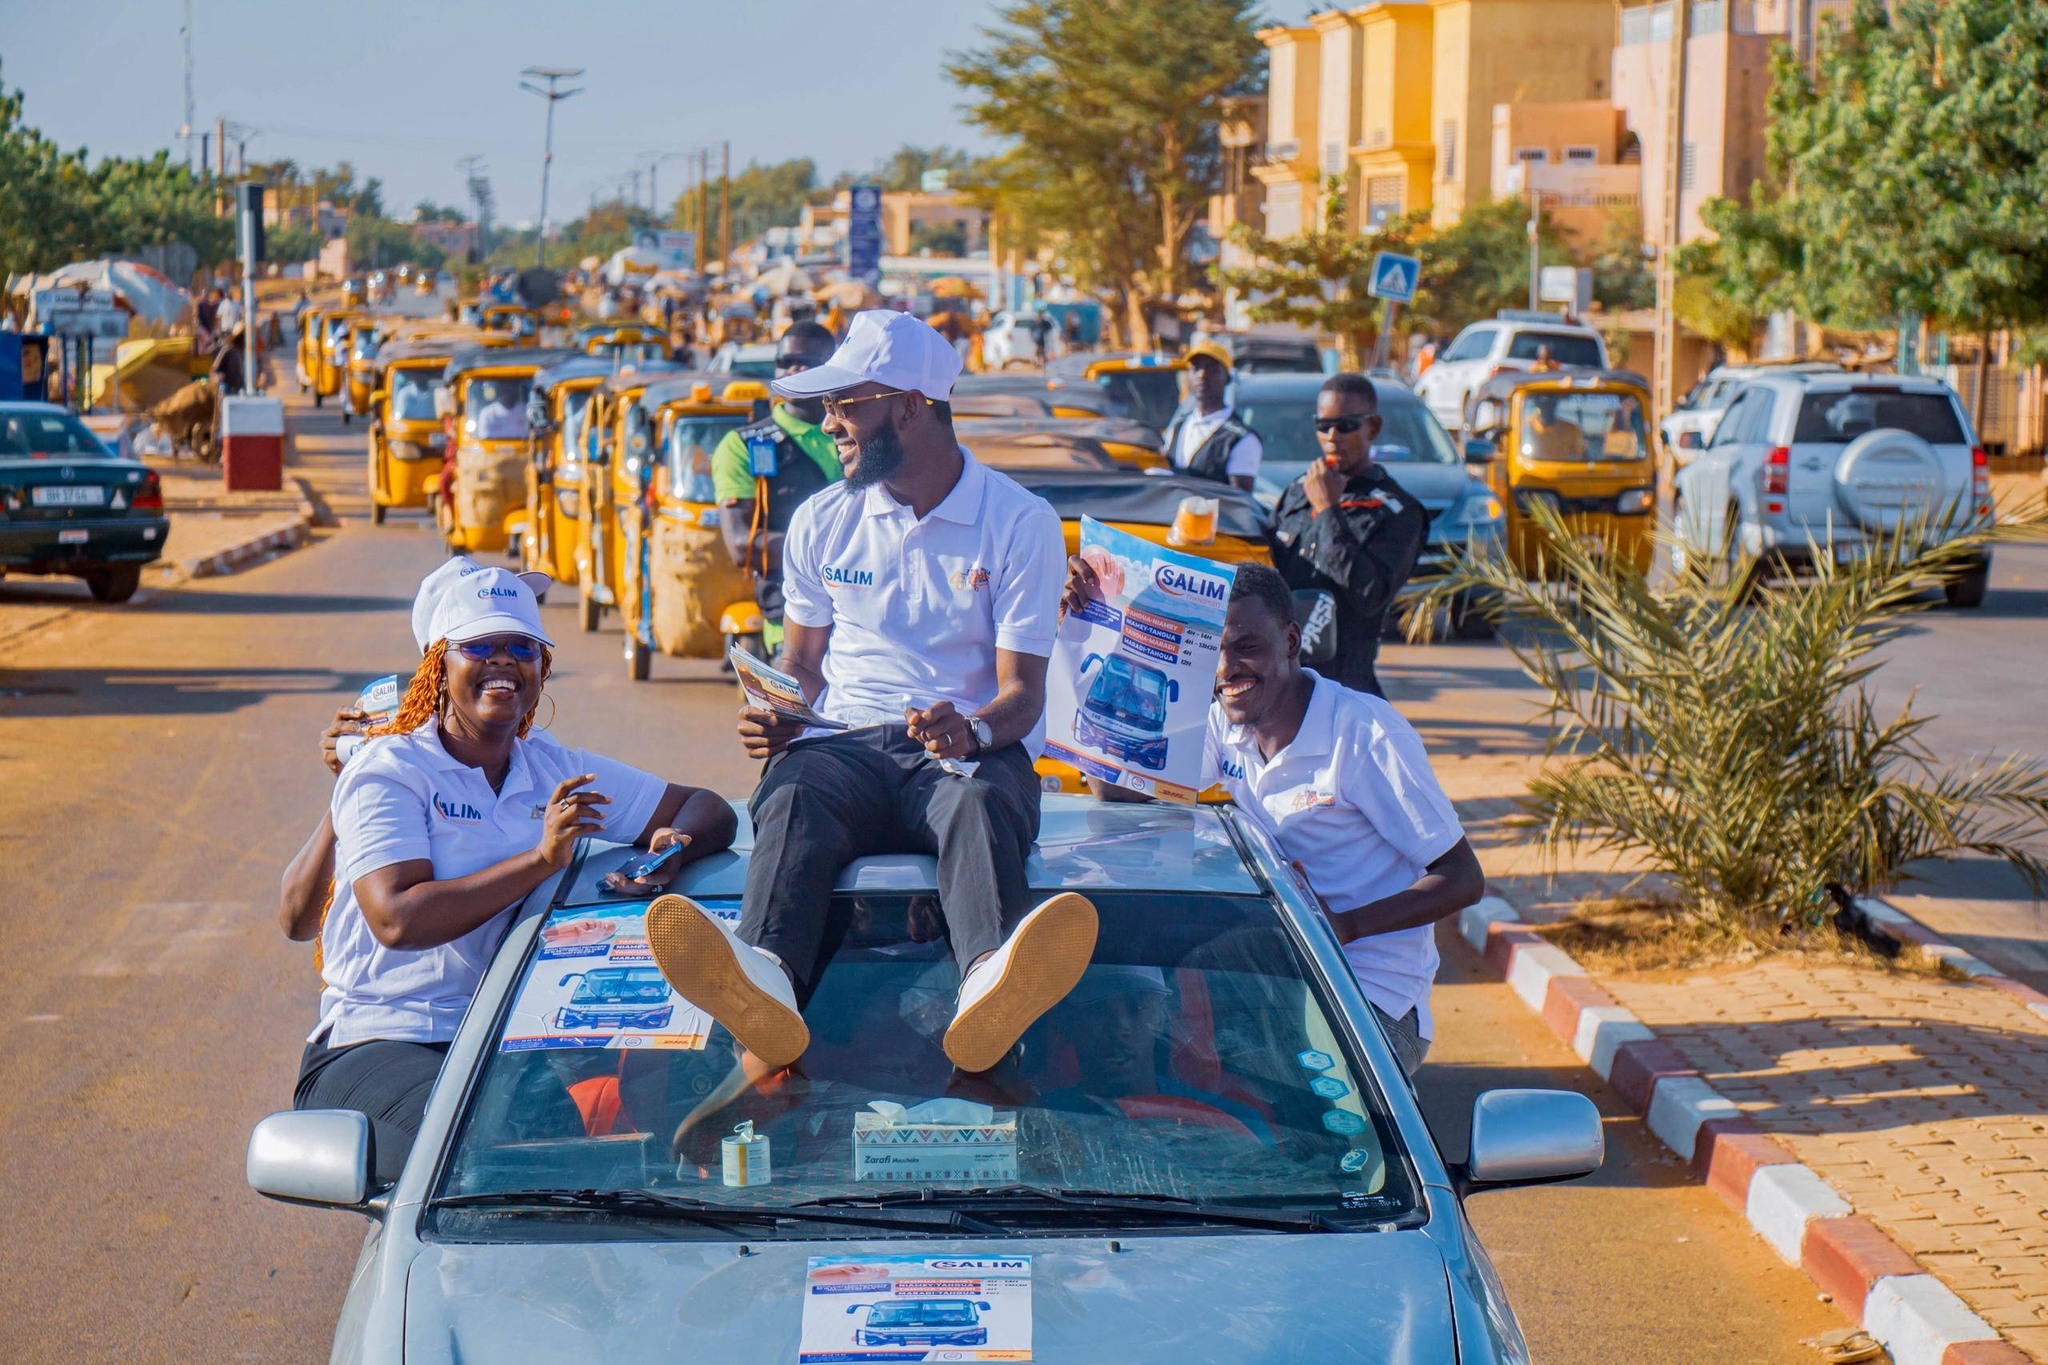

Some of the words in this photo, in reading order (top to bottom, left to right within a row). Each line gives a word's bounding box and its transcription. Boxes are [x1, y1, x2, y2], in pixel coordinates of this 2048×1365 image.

[825, 567, 873, 586] SALIM
[1162, 569, 1226, 601] SALIM
[482, 587, 518, 598] SALIM
[1126, 607, 1178, 631] TAHOUA-NIAMEY
[1125, 618, 1177, 642] NIAMEY-TAHOUA
[1123, 637, 1174, 662] MARADI-TAHOUA
[376, 684, 396, 697] SALIM
[439, 801, 482, 820] ALIM
[864, 1155, 891, 1164] Zarafi
